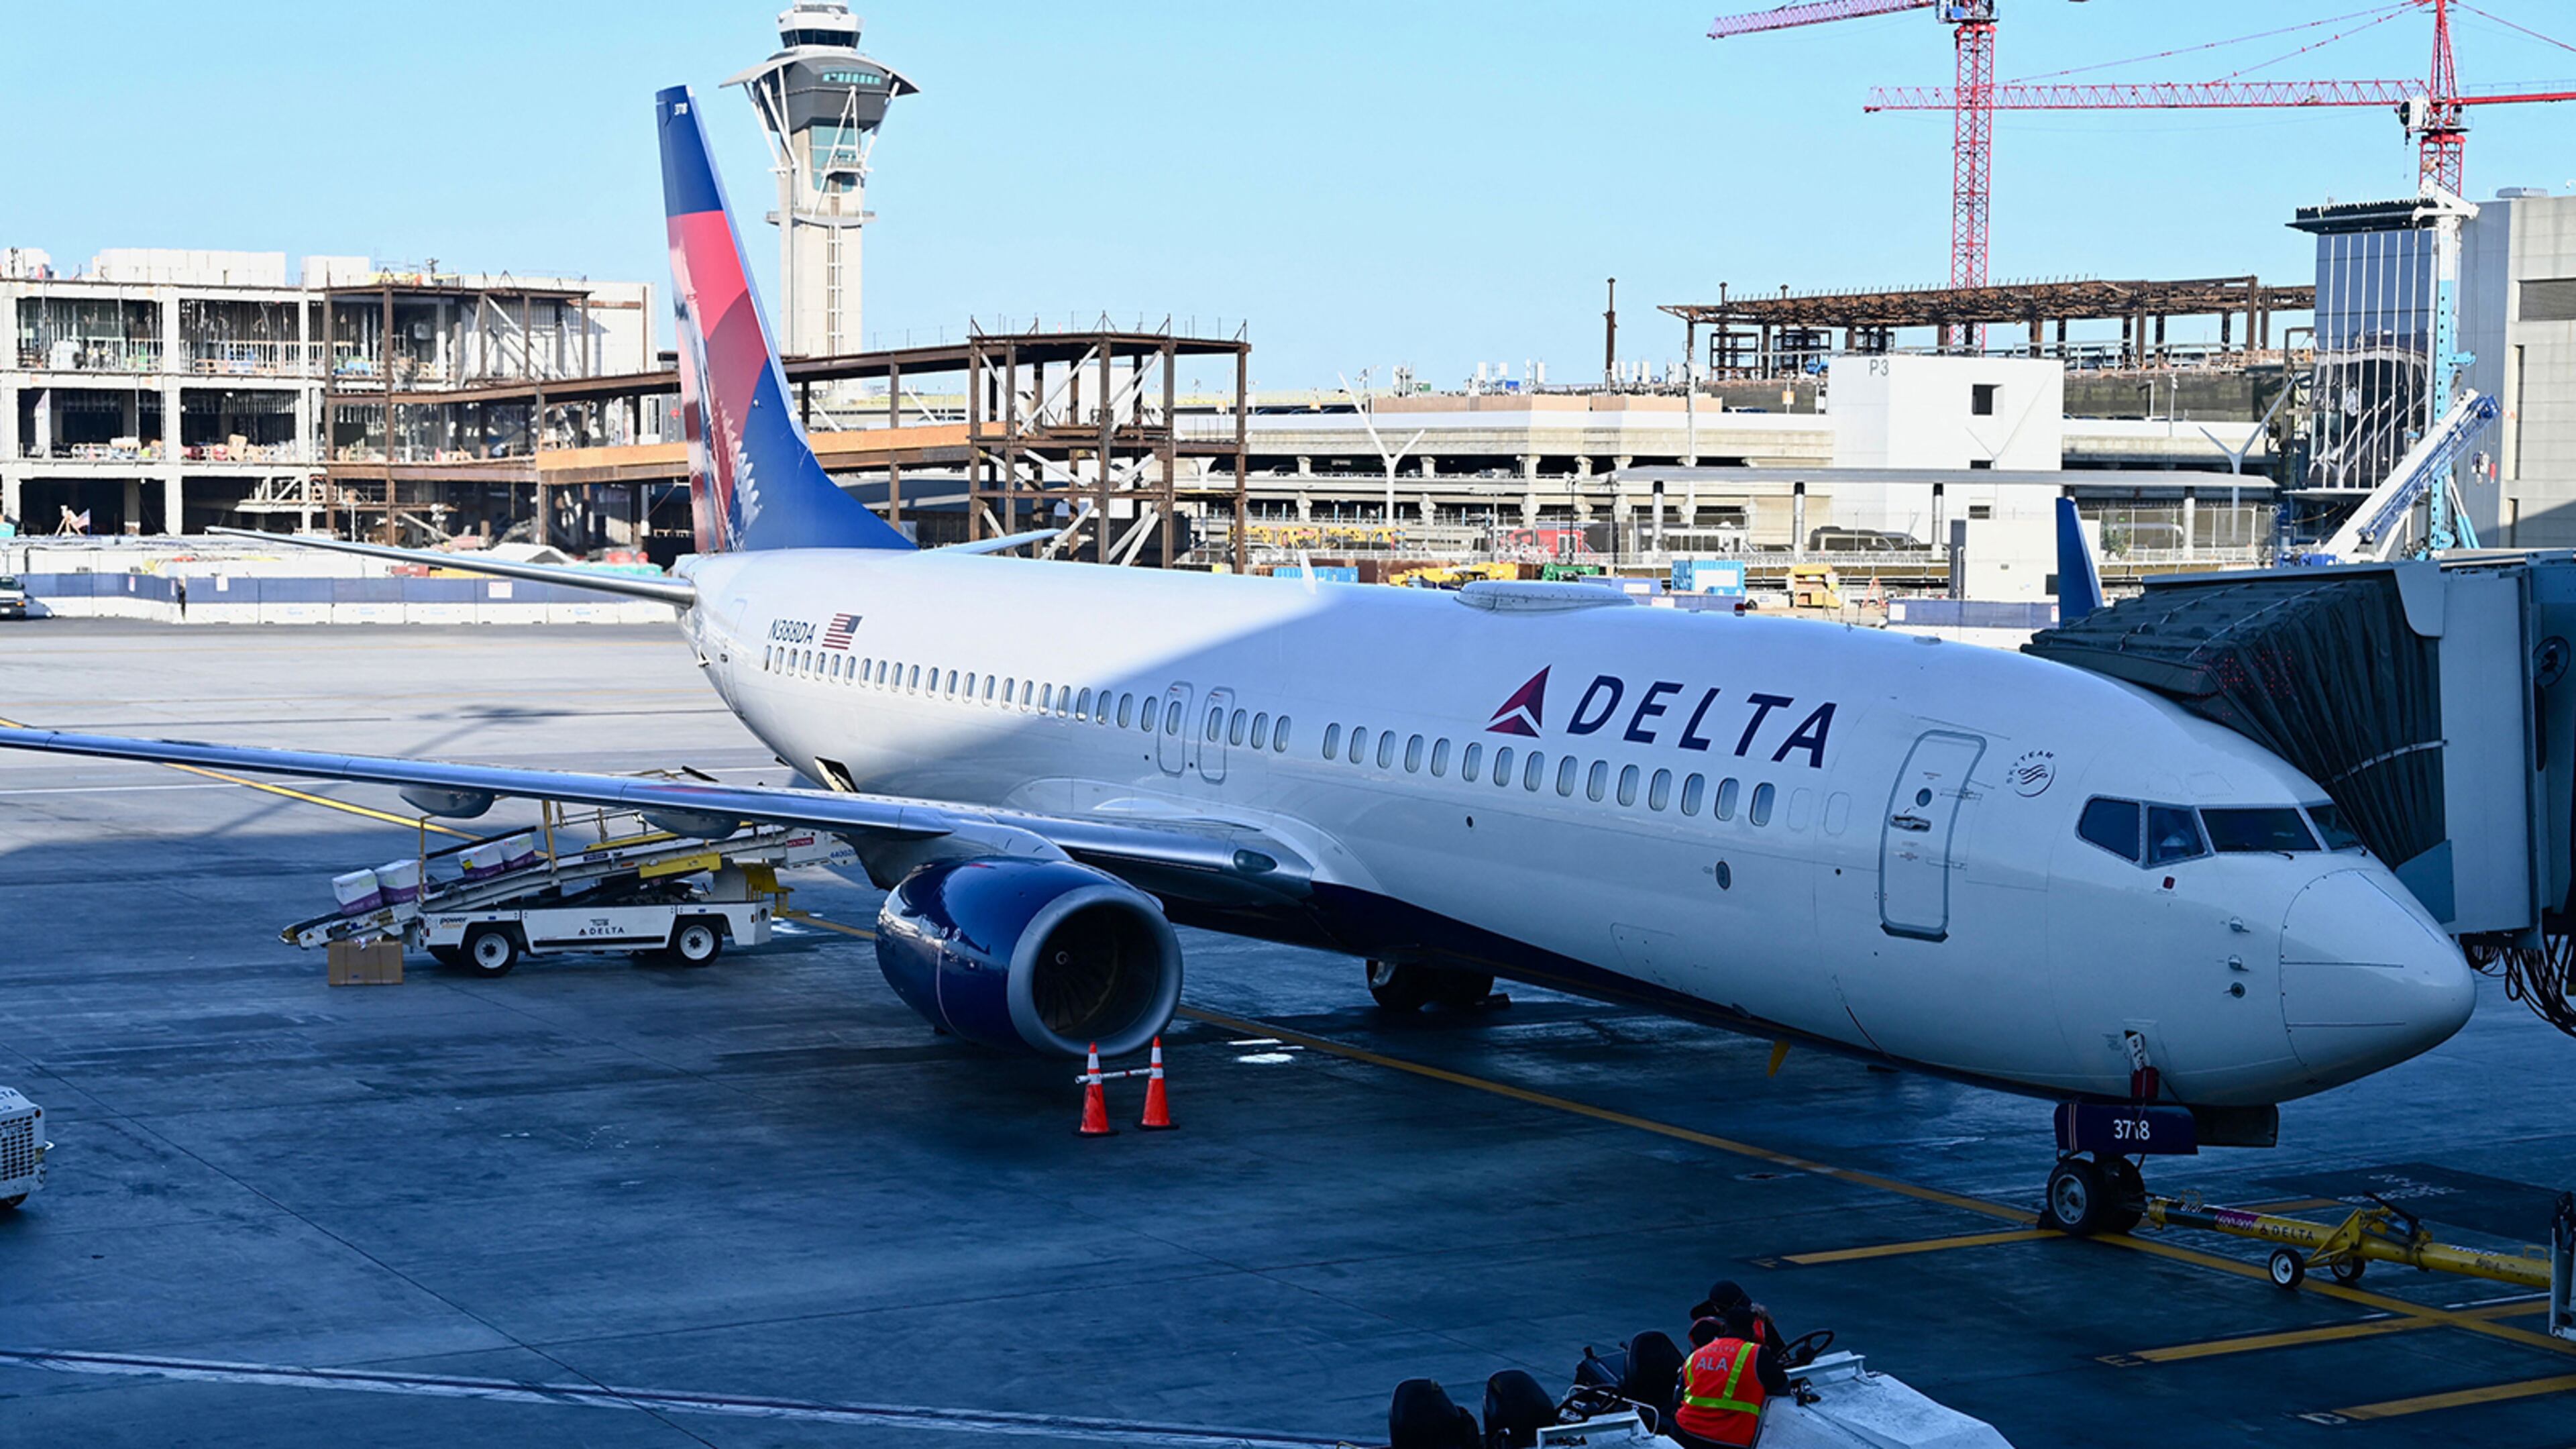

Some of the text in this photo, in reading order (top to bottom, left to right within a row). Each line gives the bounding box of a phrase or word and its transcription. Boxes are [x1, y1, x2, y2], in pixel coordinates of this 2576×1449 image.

[1869, 358, 1890, 377] P3
[767, 618, 817, 645] N388DA
[1566, 674, 1838, 769] DELTA
[589, 926, 625, 936] DELTA
[2113, 1118, 2151, 1140] 3718
[2271, 1224, 2314, 1241] DELTA
[1695, 1356, 1729, 1373] ALA
